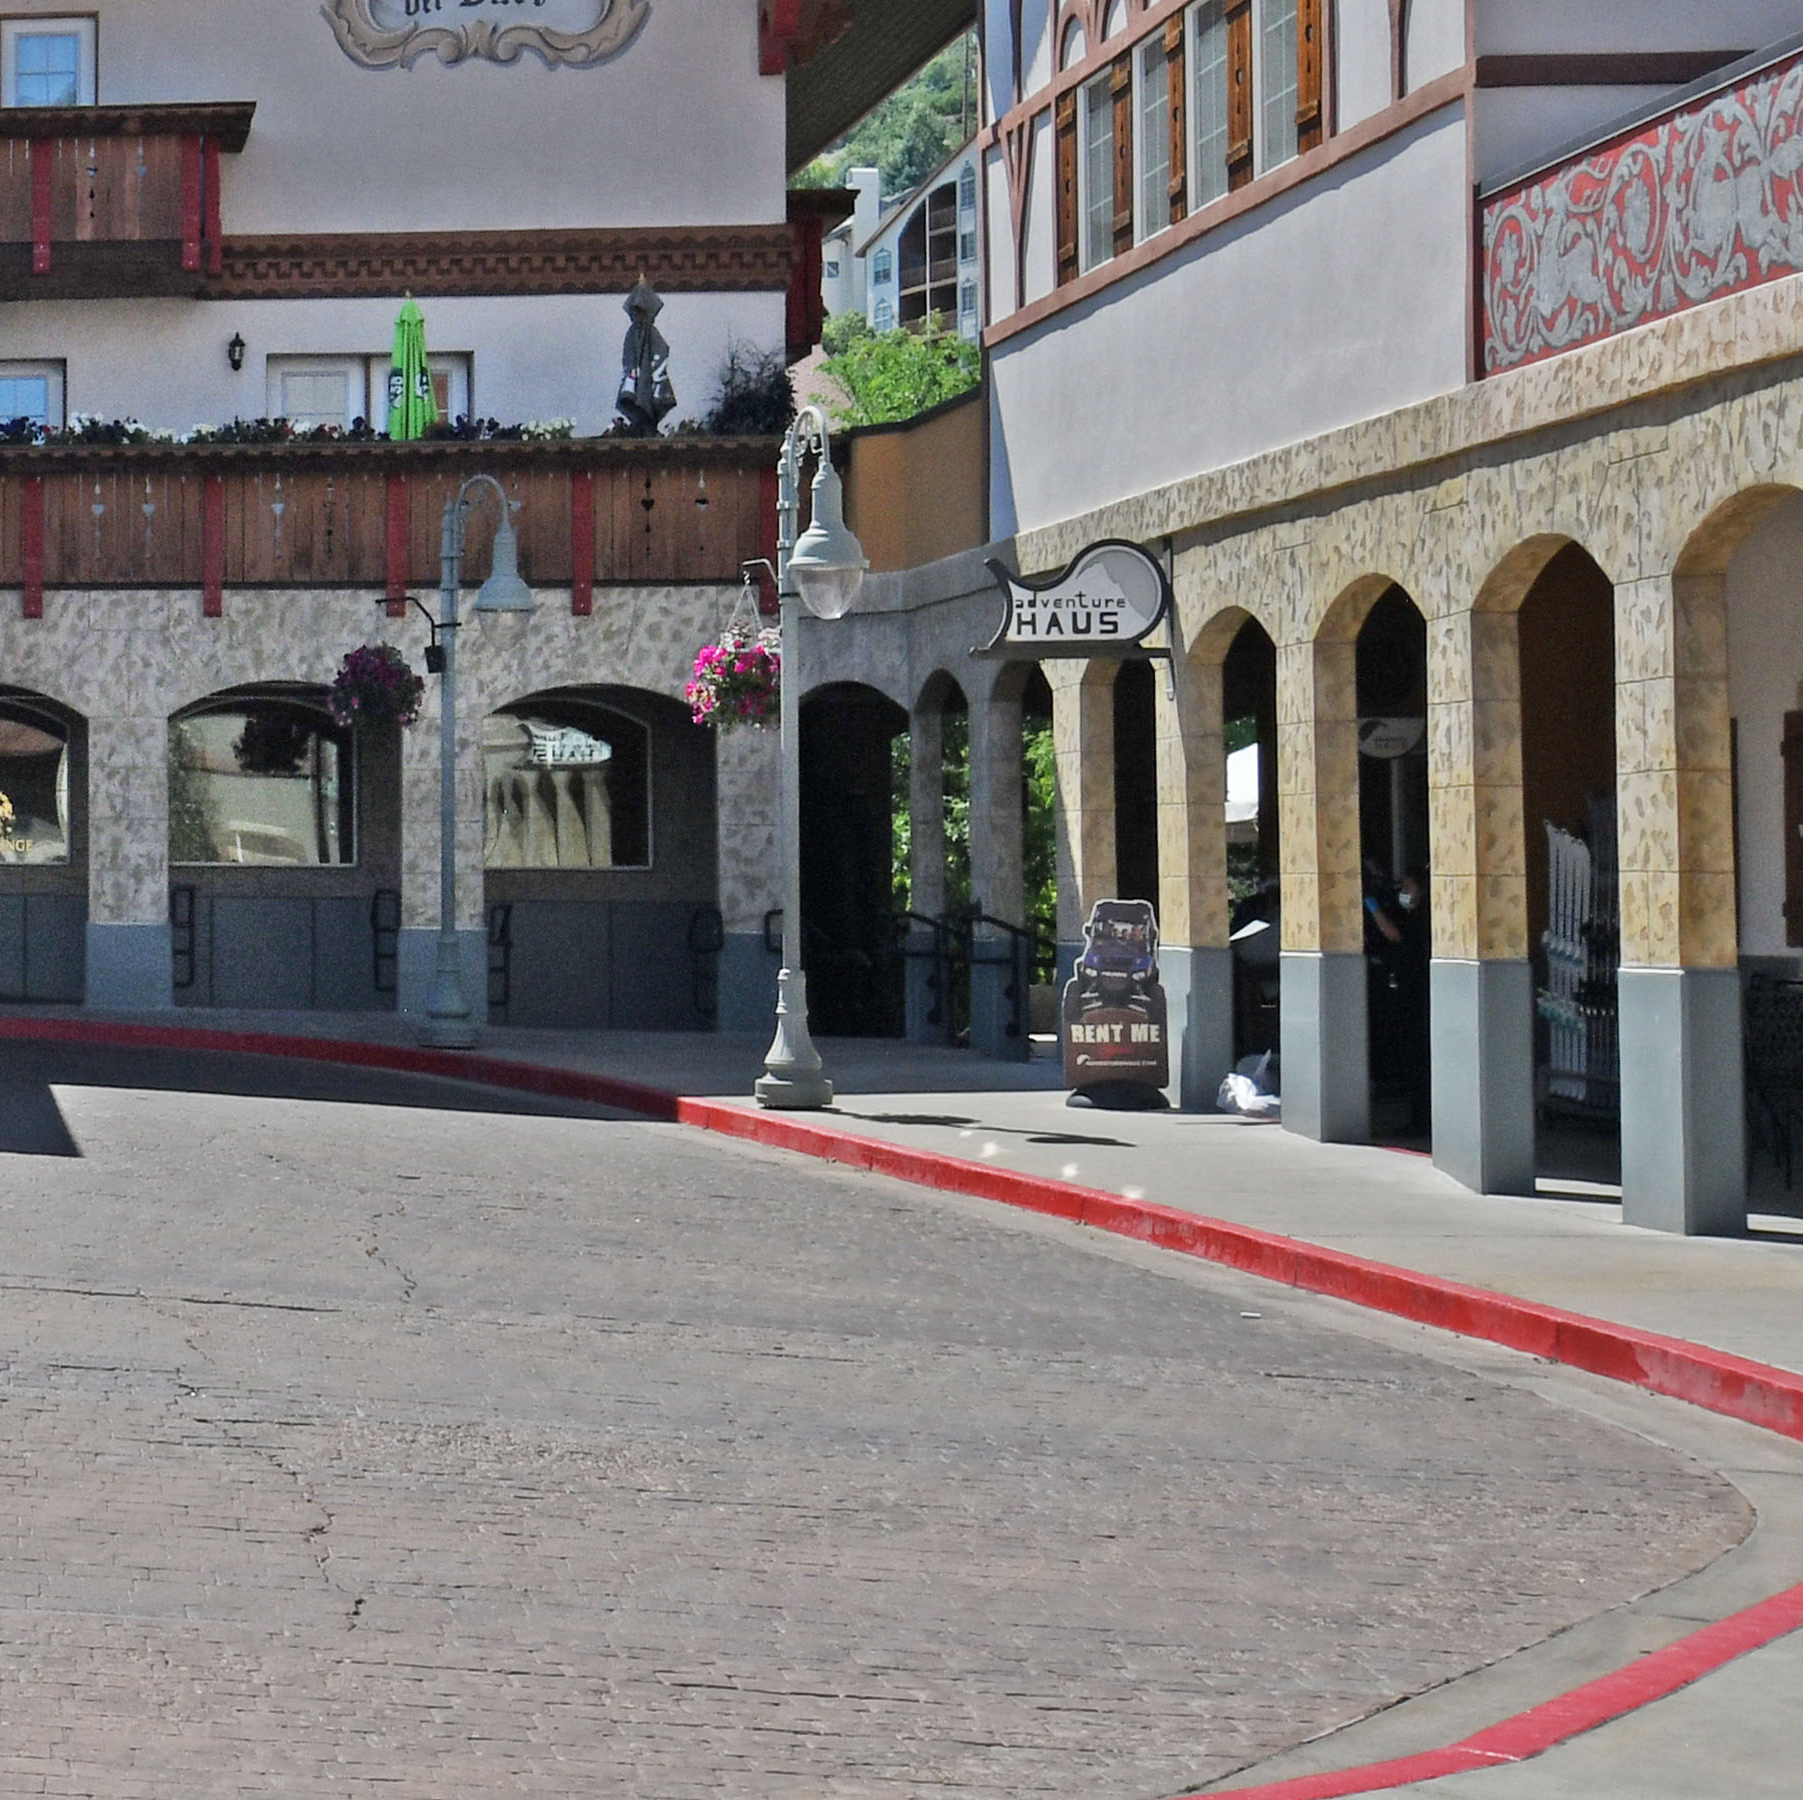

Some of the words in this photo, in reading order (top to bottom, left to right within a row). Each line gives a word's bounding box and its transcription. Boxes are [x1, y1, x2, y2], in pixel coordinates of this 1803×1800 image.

[1015, 590, 1127, 608] adventure
[1016, 611, 1119, 636] HAUS
[1070, 1023, 1123, 1044] RENT
[1130, 1023, 1160, 1044] ME
